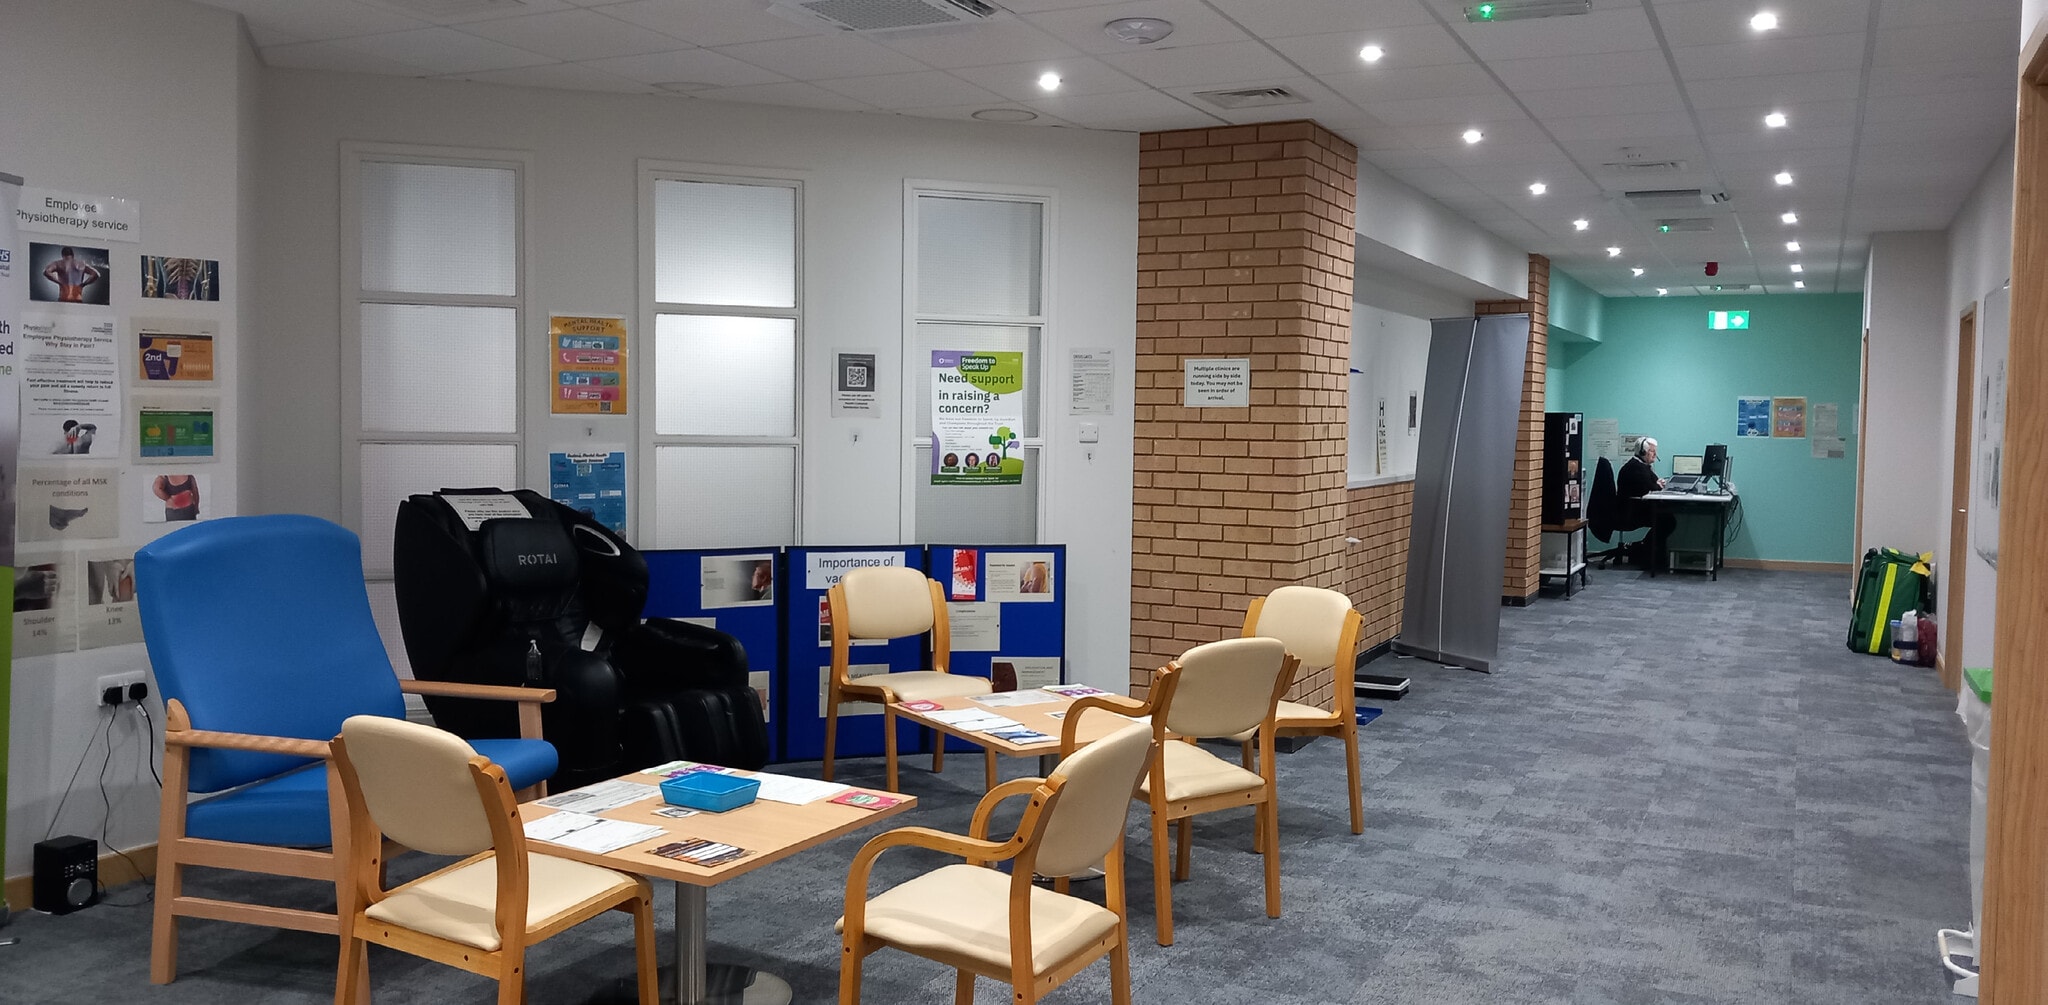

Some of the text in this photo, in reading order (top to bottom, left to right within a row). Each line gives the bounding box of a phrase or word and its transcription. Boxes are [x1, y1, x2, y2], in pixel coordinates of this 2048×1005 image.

[91, 219, 129, 231] service
[0, 251, 9, 261] HS
[0, 320, 10, 334] th
[0, 341, 14, 355] ed
[145, 353, 162, 361] 2nd
[939, 373, 1014, 386] Need support
[938, 390, 1000, 403] in raising a
[938, 404, 990, 414] concern?
[1379, 401, 1385, 417] H
[167, 447, 174, 455] 3
[32, 479, 72, 487] Percentage
[518, 553, 557, 565] ROTAI
[819, 556, 894, 570] Importance of
[825, 575, 843, 584] vac
[106, 605, 123, 613] Knee
[23, 616, 55, 626] Shoulder
